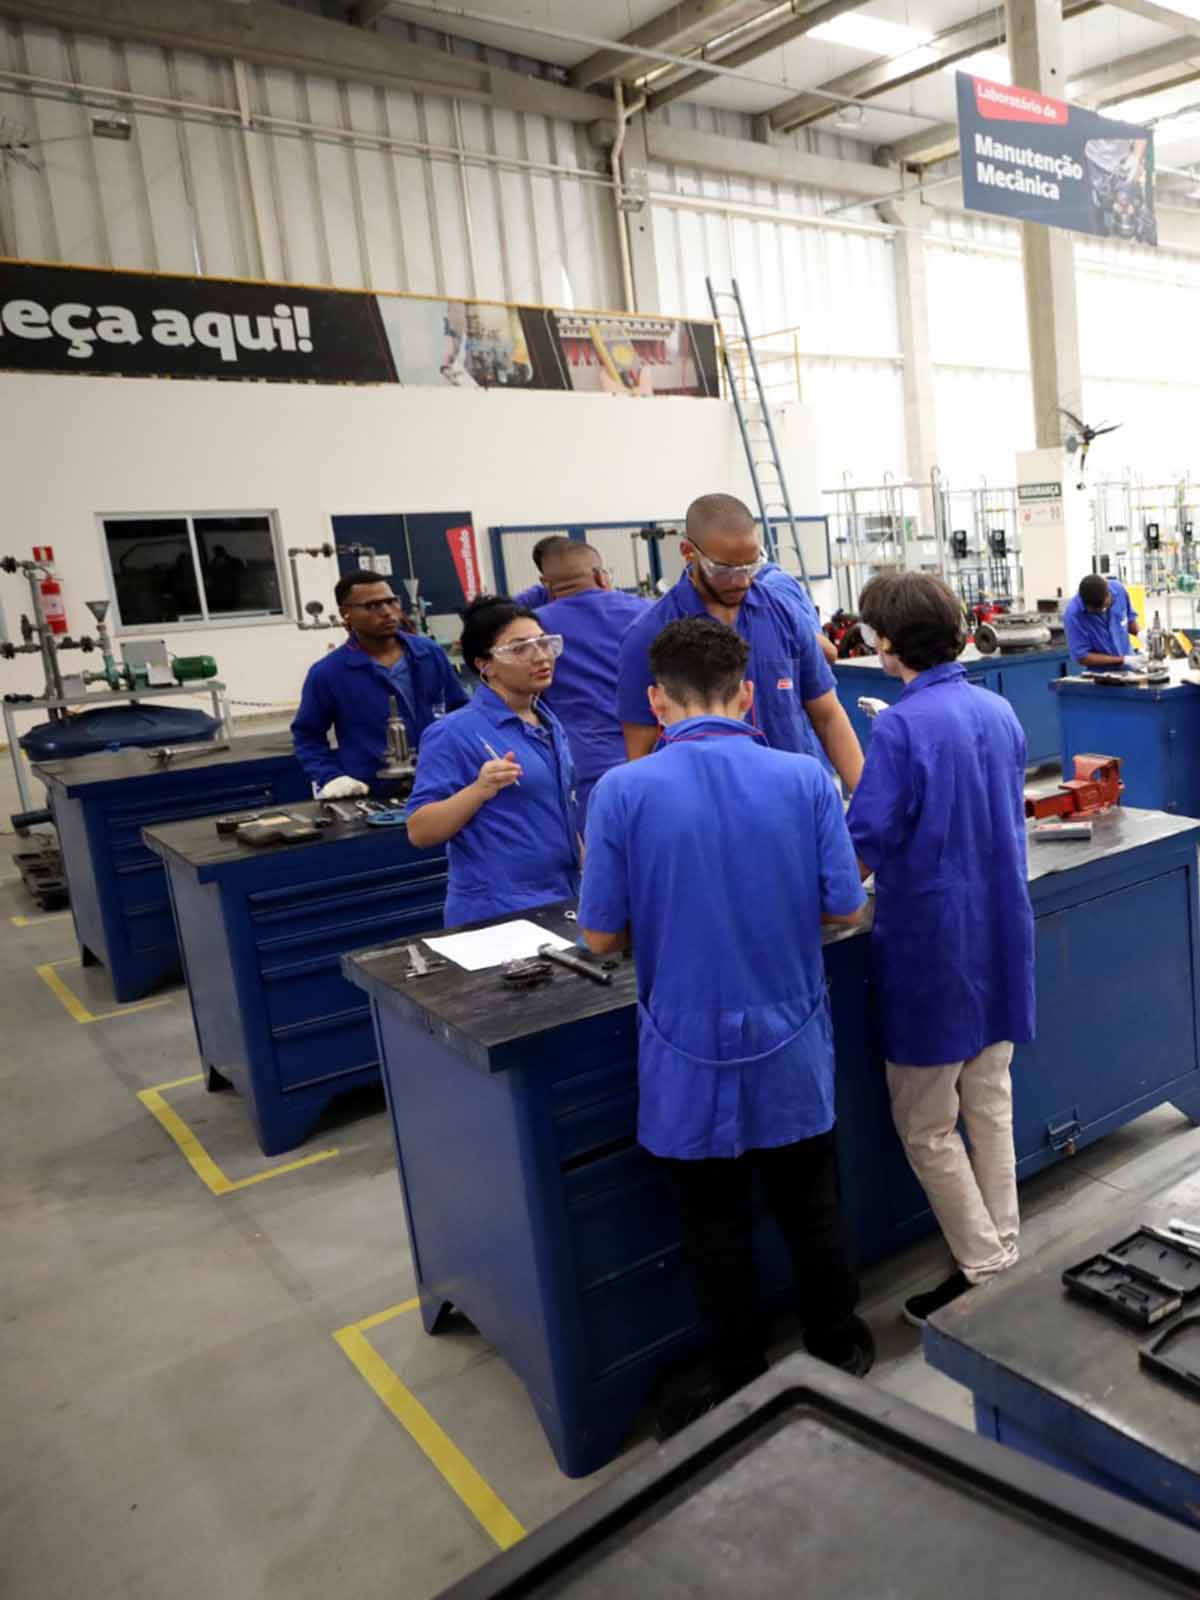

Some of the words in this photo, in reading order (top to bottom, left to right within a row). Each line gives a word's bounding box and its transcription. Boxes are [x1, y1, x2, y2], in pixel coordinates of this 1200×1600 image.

[976, 83, 1042, 116] Laboratório
[1043, 104, 1057, 119] de
[974, 132, 1083, 181] Manutenção
[976, 161, 1060, 200] Mecânica
[0, 299, 143, 358] eça
[151, 303, 314, 362] aqui!
